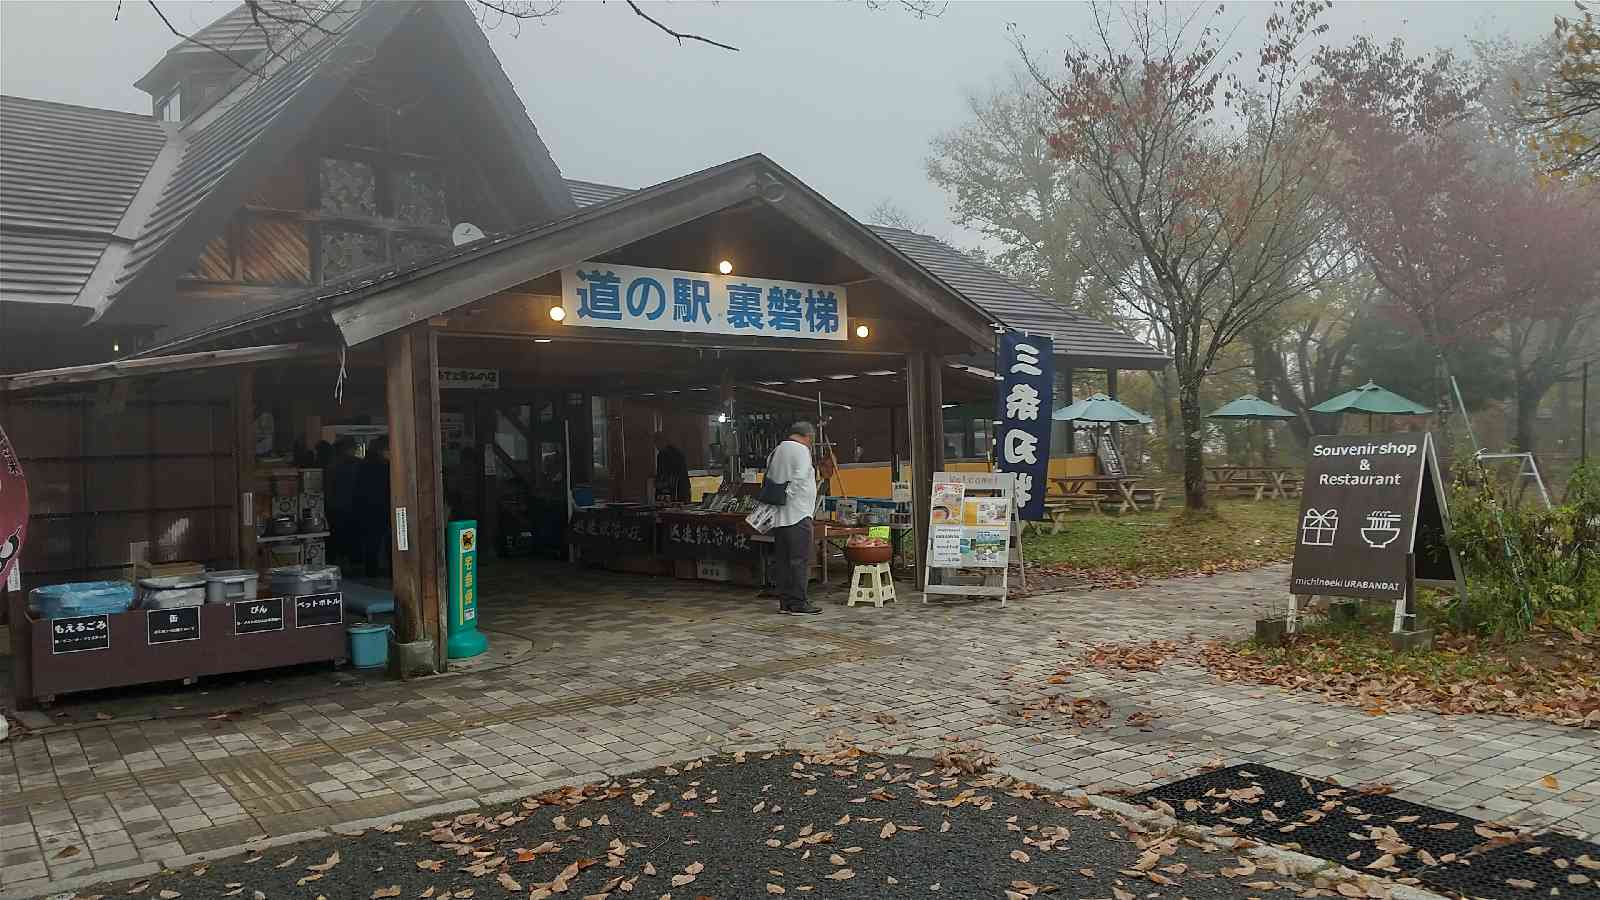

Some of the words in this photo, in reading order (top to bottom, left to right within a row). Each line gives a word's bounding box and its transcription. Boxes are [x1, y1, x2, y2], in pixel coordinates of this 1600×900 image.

[576, 269, 712, 325] 道の駅
[726, 283, 839, 334] 裏磐梯
[1313, 443, 1378, 457] Souvenir
[1379, 442, 1417, 456] shop
[1359, 459, 1371, 471] &
[1319, 473, 1402, 486] Restaurant
[1344, 580, 1399, 591] URABANDAI
[250, 605, 268, 614] びん
[296, 598, 341, 609] ペットボトル
[55, 620, 107, 634] もえるごみ
